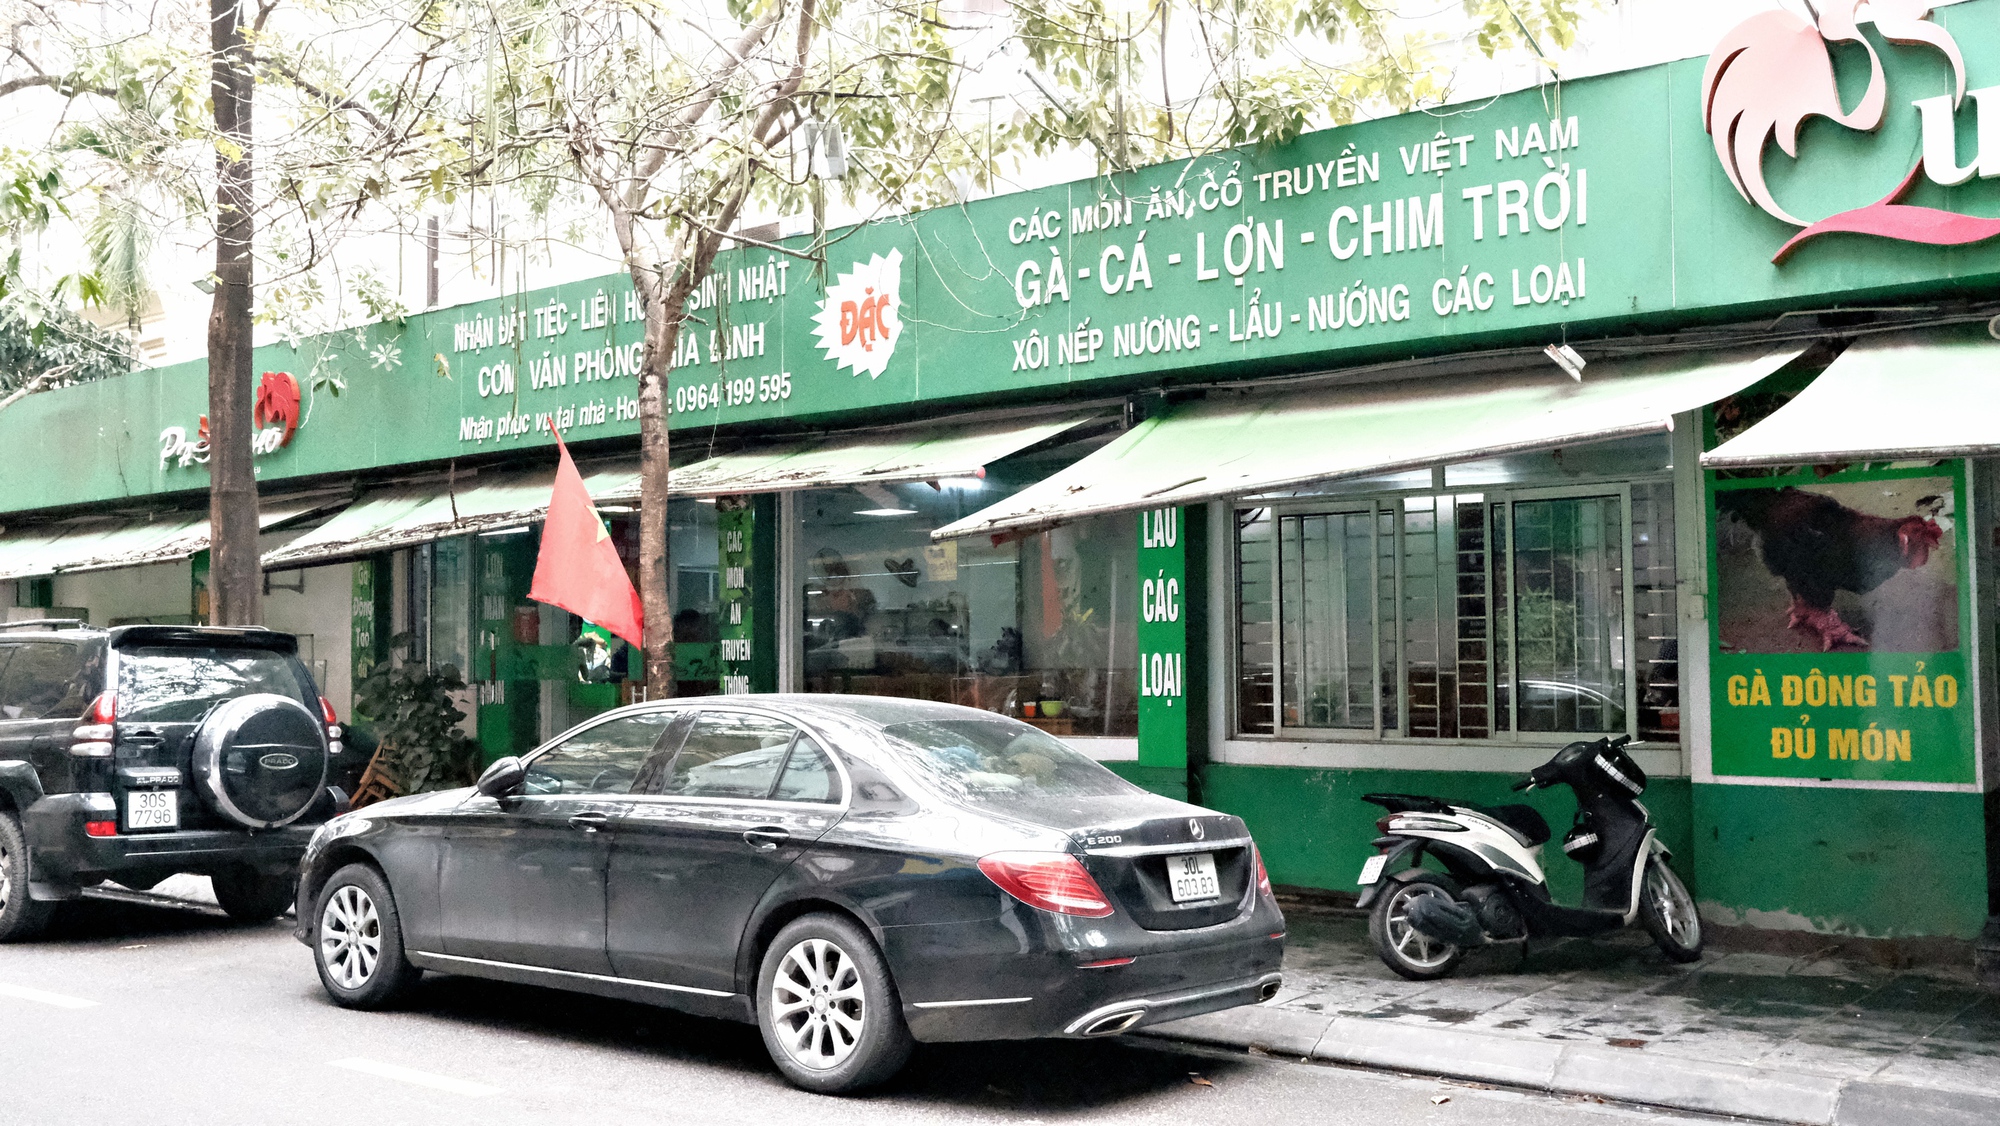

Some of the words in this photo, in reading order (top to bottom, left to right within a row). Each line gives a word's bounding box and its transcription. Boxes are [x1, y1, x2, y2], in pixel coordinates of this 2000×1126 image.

[1009, 207, 1061, 245] CÁC
[1072, 194, 1132, 234] MÓN
[1199, 161, 1242, 210] CỔ
[1253, 142, 1379, 202] TRUYỀN
[1399, 131, 1474, 177] VIỆT
[1495, 116, 1578, 160] NAM
[1015, 246, 1069, 309] GÀ
[1100, 230, 1153, 295] CÁ
[1196, 216, 1284, 287] LỢN
[1328, 192, 1444, 260] CHIM
[1462, 156, 1587, 241] TRỜI
[454, 313, 493, 355] NHẬN
[498, 305, 526, 349] ĐẶT
[534, 298, 568, 343] TIỆC
[738, 255, 790, 304] NHẬT
[840, 286, 889, 352] ĐẶC
[1012, 329, 1049, 371] XÔI
[1058, 317, 1104, 365] NẾP
[1114, 314, 1201, 358] NƯƠNG
[1229, 288, 1282, 342] LẨU
[1308, 279, 1410, 331] NƯỚNG
[1432, 265, 1494, 316] CÁC
[1512, 257, 1586, 307] LOẠI
[529, 351, 567, 390] VĂN
[574, 338, 644, 384] PHÒNG
[459, 416, 493, 445] Nhận
[497, 411, 530, 442] phục
[536, 412, 552, 437] vụ
[556, 403, 575, 434] tại
[579, 398, 605, 426] nhà
[676, 383, 719, 412] 0964
[725, 377, 755, 406] 199
[759, 372, 791, 403] 595
[727, 526, 743, 553] CÁC
[726, 562, 745, 589] MÓN
[1143, 569, 1179, 622] CÁC
[730, 599, 742, 625] ĂN
[1141, 652, 1181, 708] LOẠI
[1727, 668, 1772, 707] GÀ
[1781, 667, 1877, 707] ĐÔNG
[1888, 660, 1958, 708] TẢO
[1770, 714, 1816, 760] ĐỦ
[1828, 722, 1912, 762] MÓN
[135, 809, 172, 826] 7796
[139, 793, 167, 808] 30S
[1181, 856, 1204, 875] 30L
